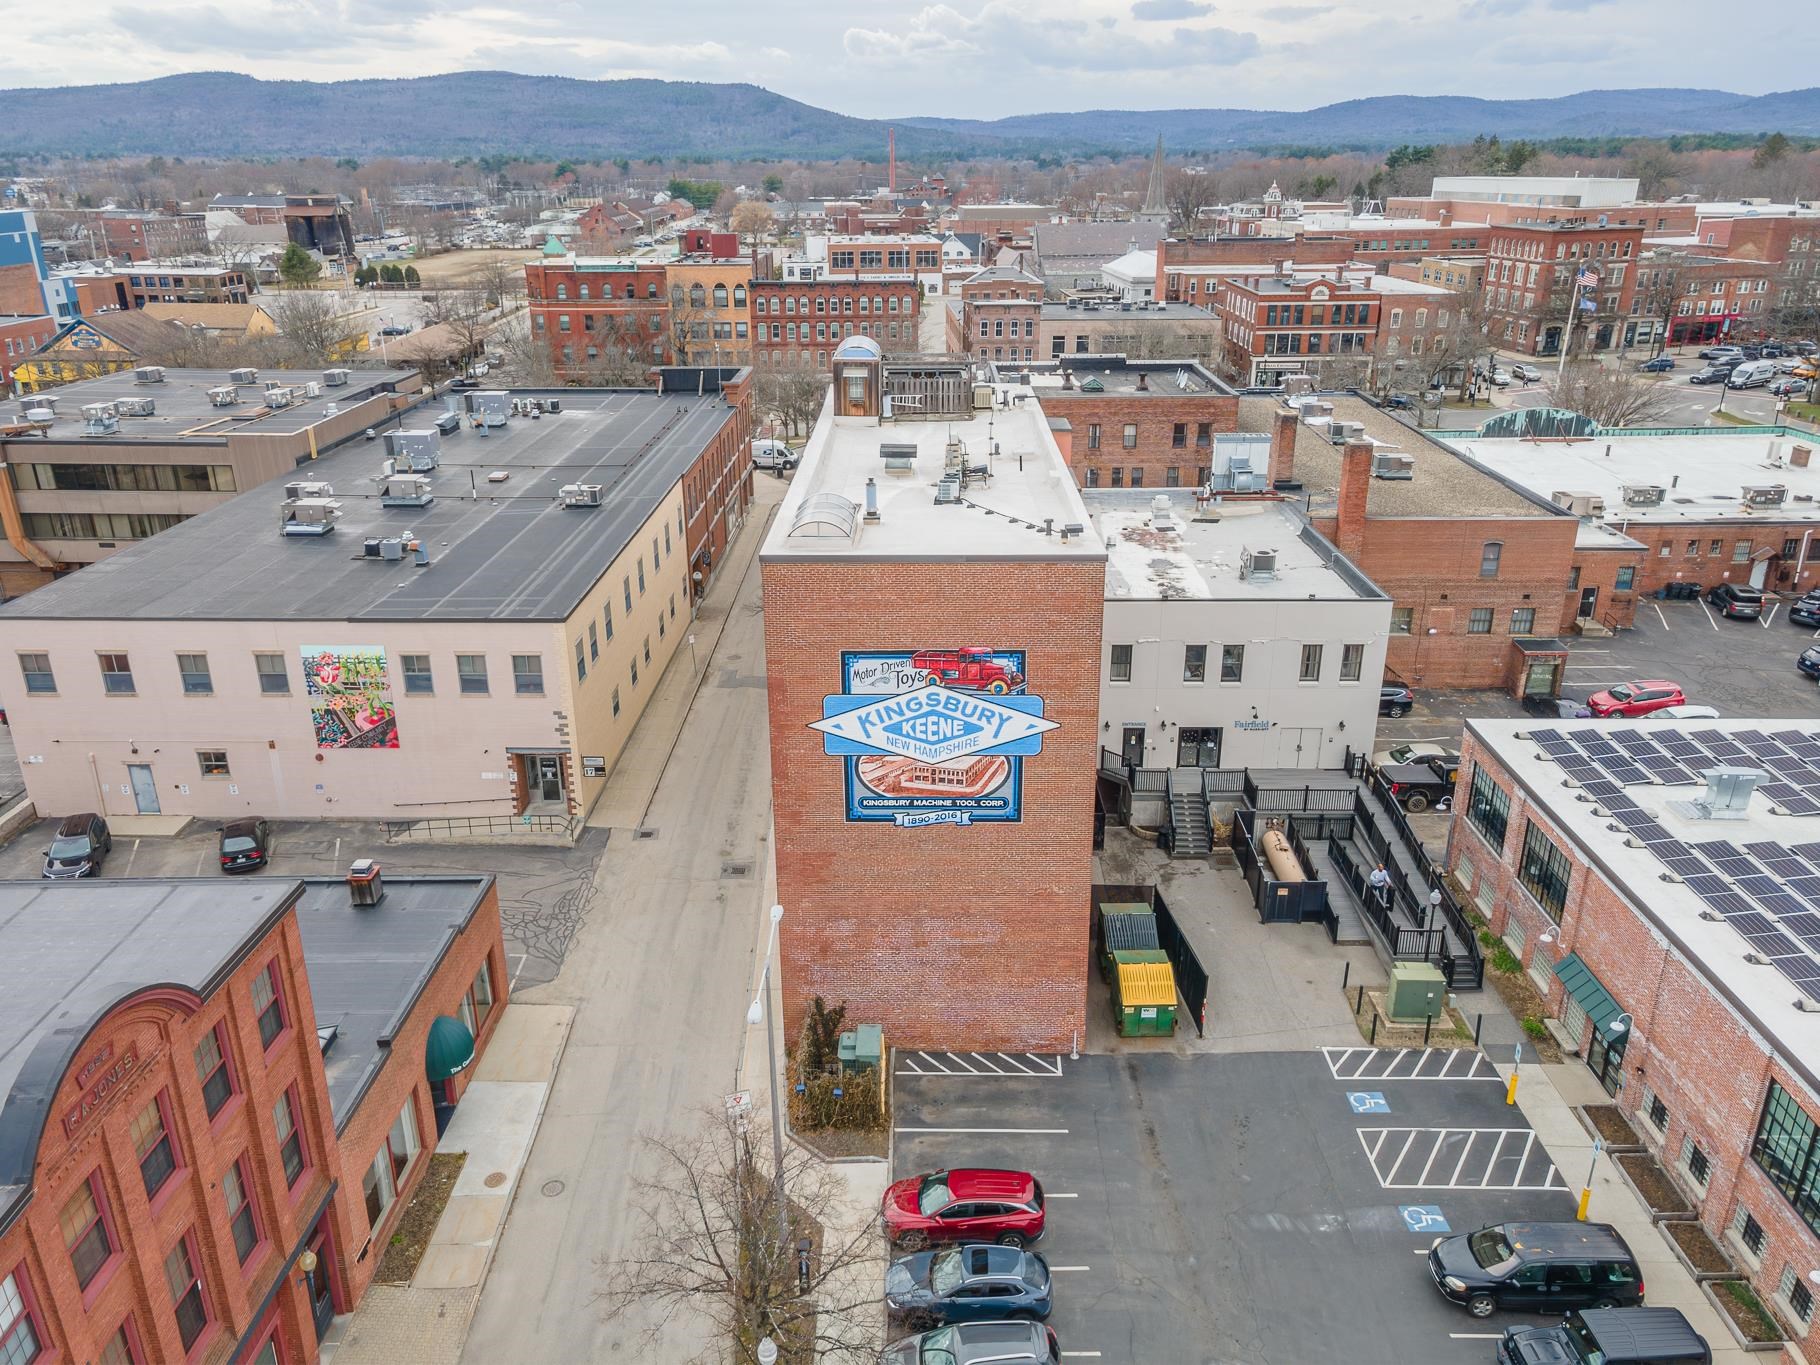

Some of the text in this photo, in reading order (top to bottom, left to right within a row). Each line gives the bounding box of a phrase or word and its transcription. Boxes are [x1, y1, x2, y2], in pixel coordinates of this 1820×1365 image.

[853, 659, 911, 683] Motor Driven
[889, 670, 925, 689] Toys
[857, 692, 1013, 739] KINGSBURY
[1234, 720, 1270, 729] Fairfield
[902, 715, 964, 741] KEENE
[886, 735, 980, 760] NEW HAMPSHIRE
[863, 799, 1004, 807] KINGSBURY MACHINE TOOL CORP.
[907, 811, 958, 825] 1890-2016
[450, 1065, 461, 1074] The
